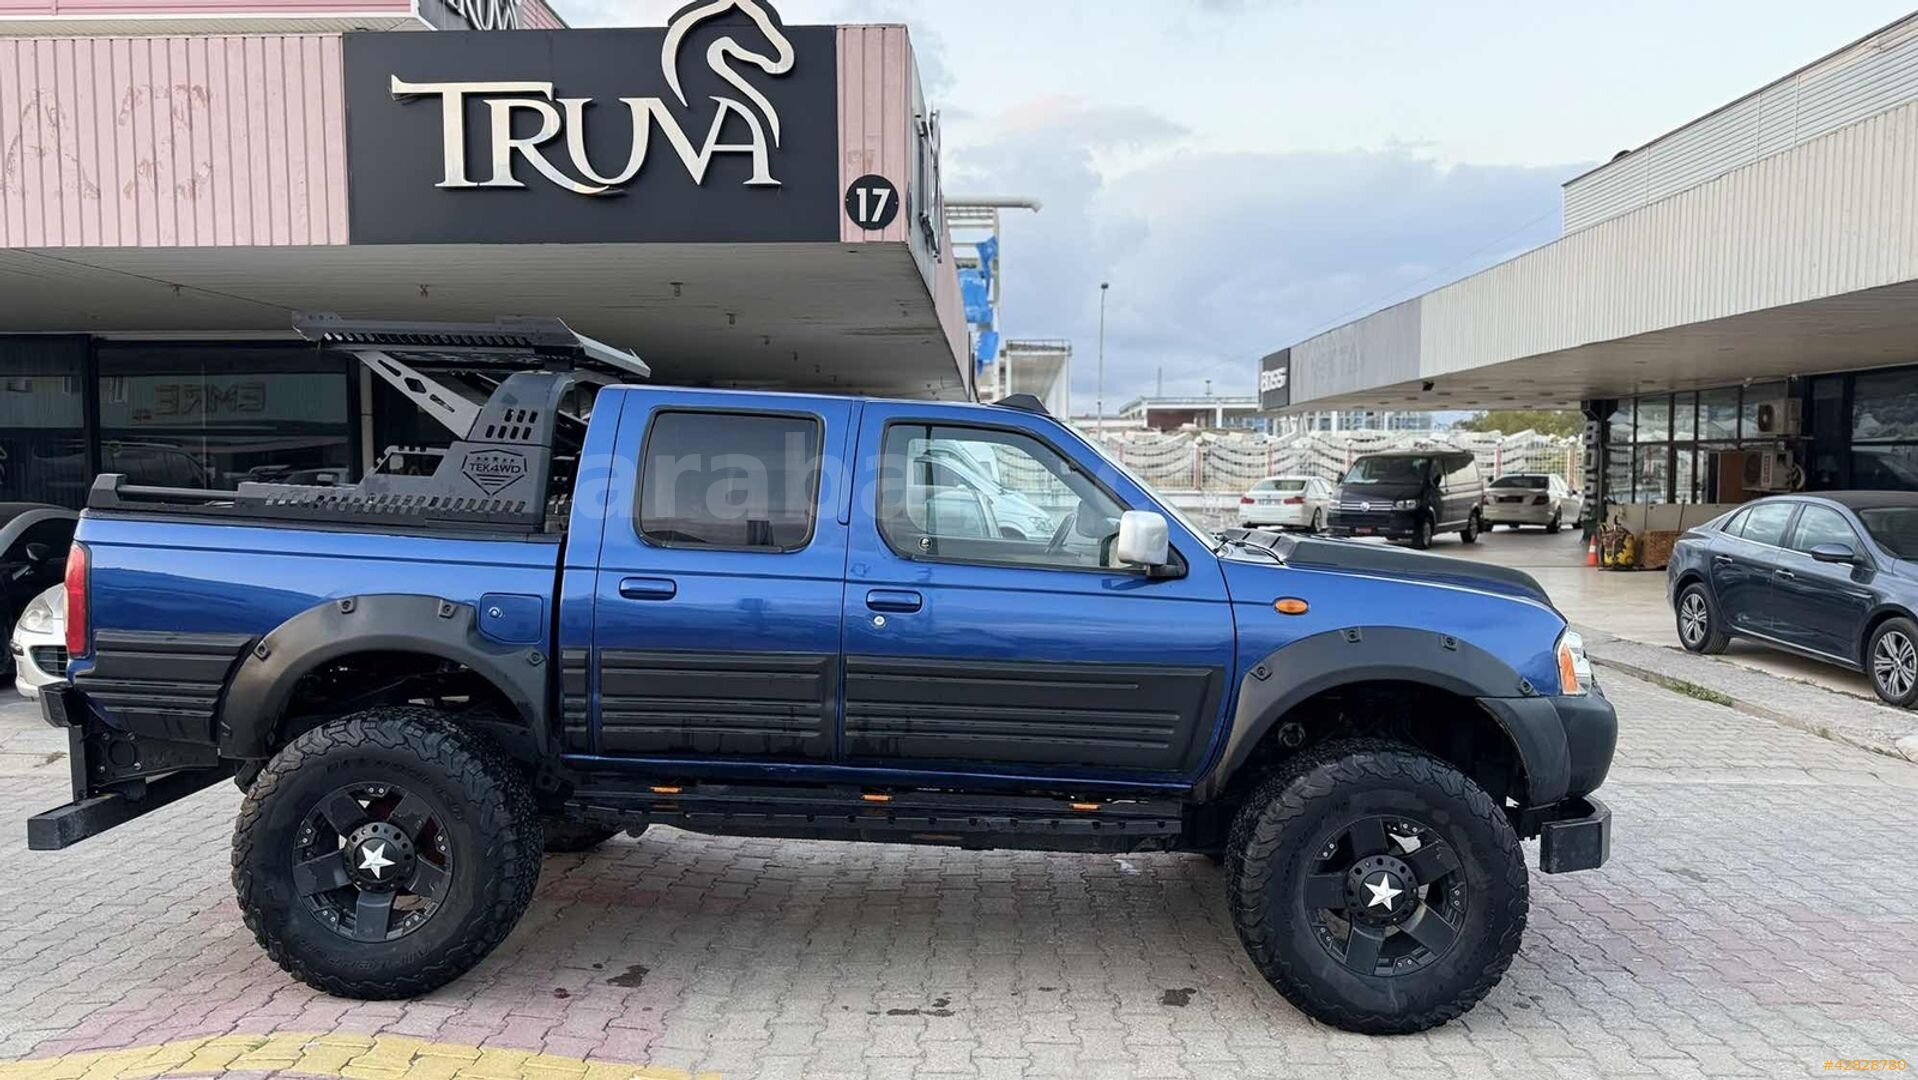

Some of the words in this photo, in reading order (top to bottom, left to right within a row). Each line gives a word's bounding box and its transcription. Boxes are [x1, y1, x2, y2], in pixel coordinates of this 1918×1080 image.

[391, 74, 782, 195] TRUVA
[856, 188, 891, 222] 17
[1261, 367, 1287, 392] BOSS
[469, 463, 522, 474] TEK4WD
